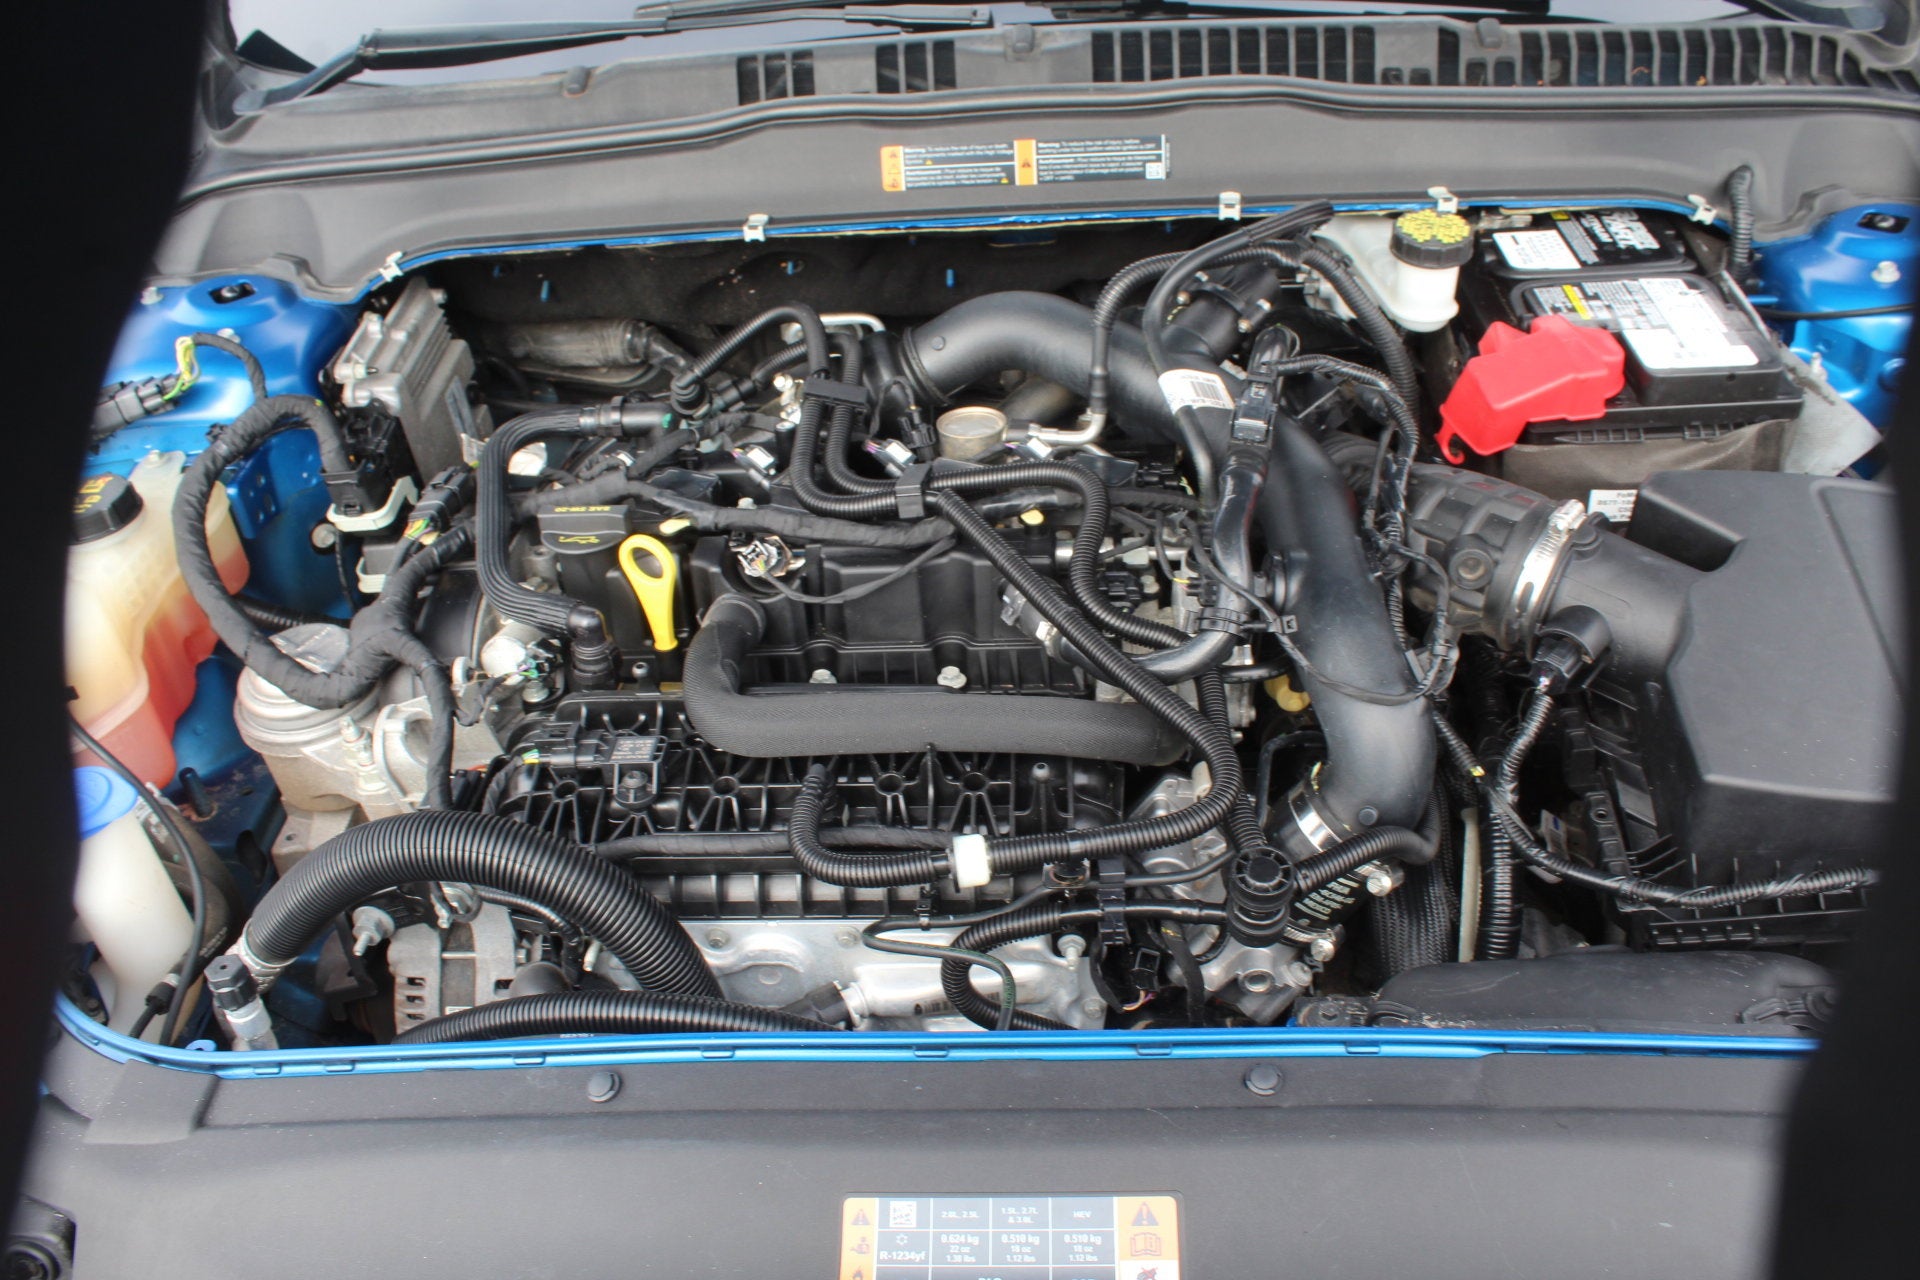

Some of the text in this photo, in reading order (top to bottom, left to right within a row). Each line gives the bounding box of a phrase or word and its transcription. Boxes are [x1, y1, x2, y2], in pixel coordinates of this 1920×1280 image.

[967, 1233, 980, 1245] kg
[1028, 1233, 1040, 1245] kg
[1089, 1233, 1102, 1245] kg
[879, 1250, 926, 1262] R-1234yf
